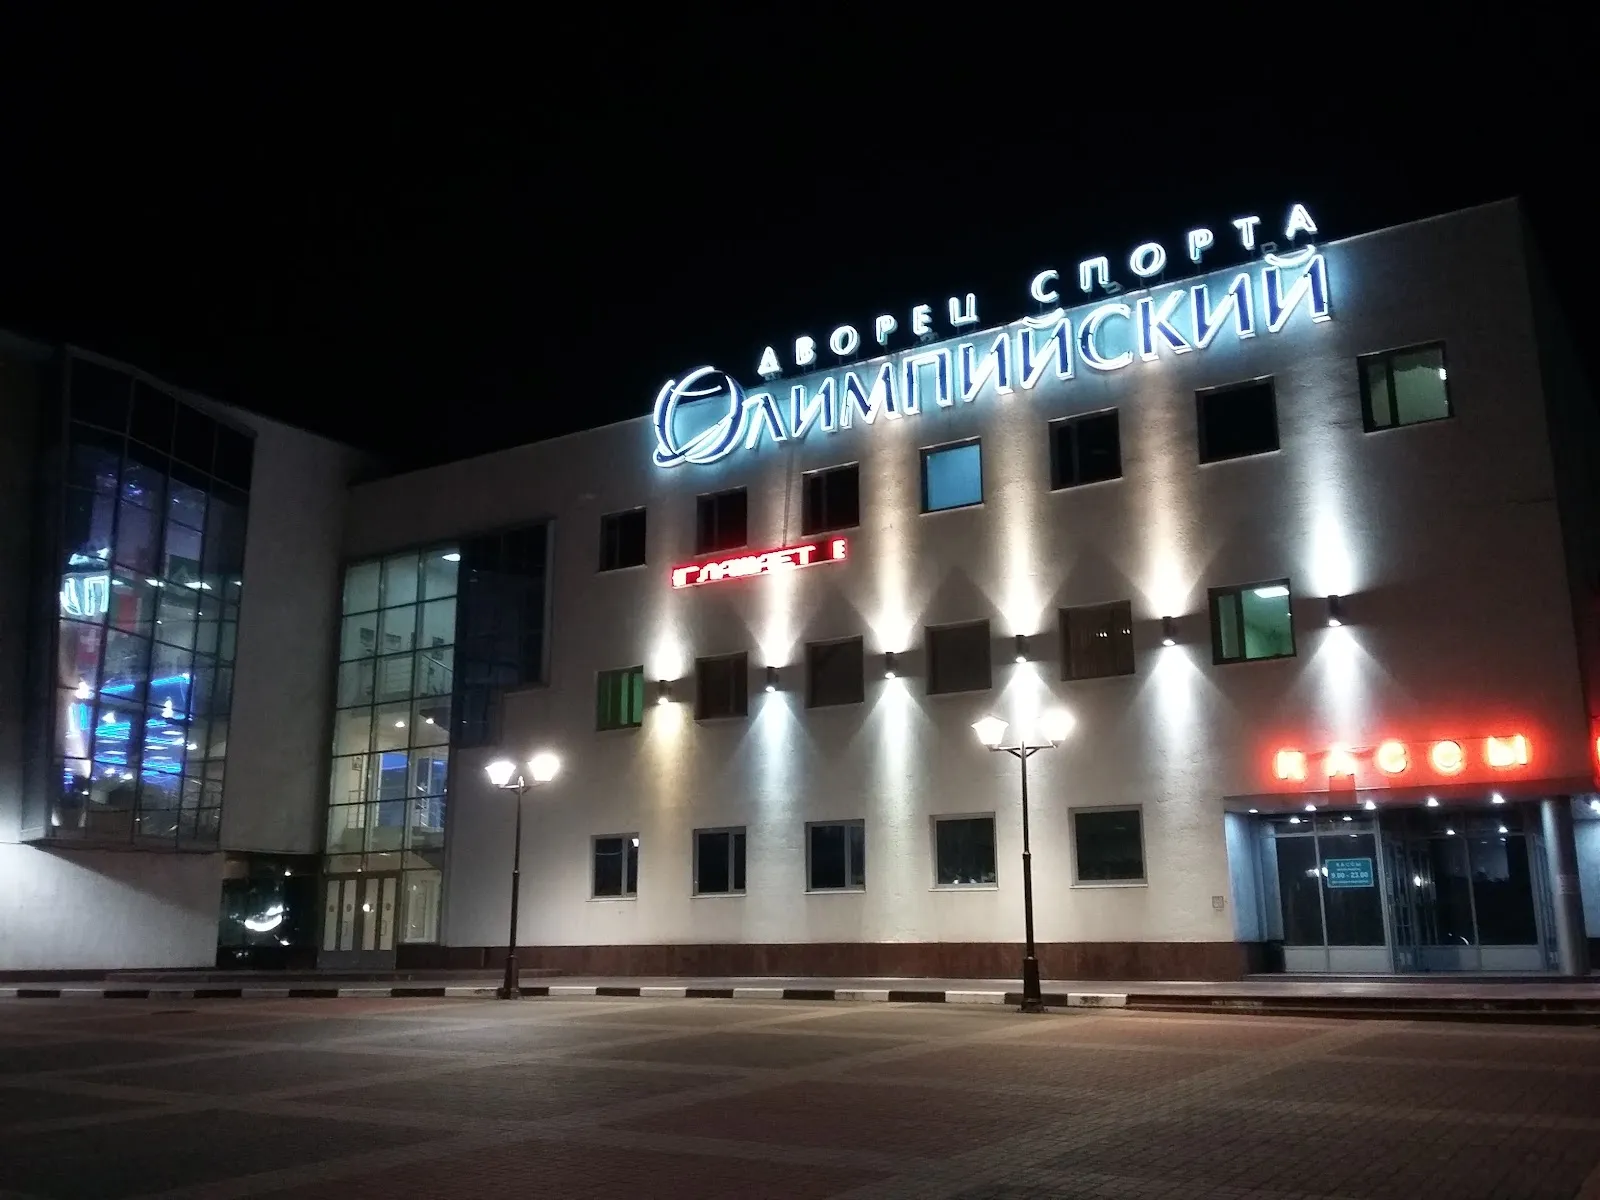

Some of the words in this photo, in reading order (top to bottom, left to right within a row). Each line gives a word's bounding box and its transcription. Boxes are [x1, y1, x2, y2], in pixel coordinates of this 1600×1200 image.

[757, 293, 980, 377] ДВОРЕЦ
[1030, 203, 1318, 303] СПОРТА
[1276, 735, 1528, 780] КАССЫ
